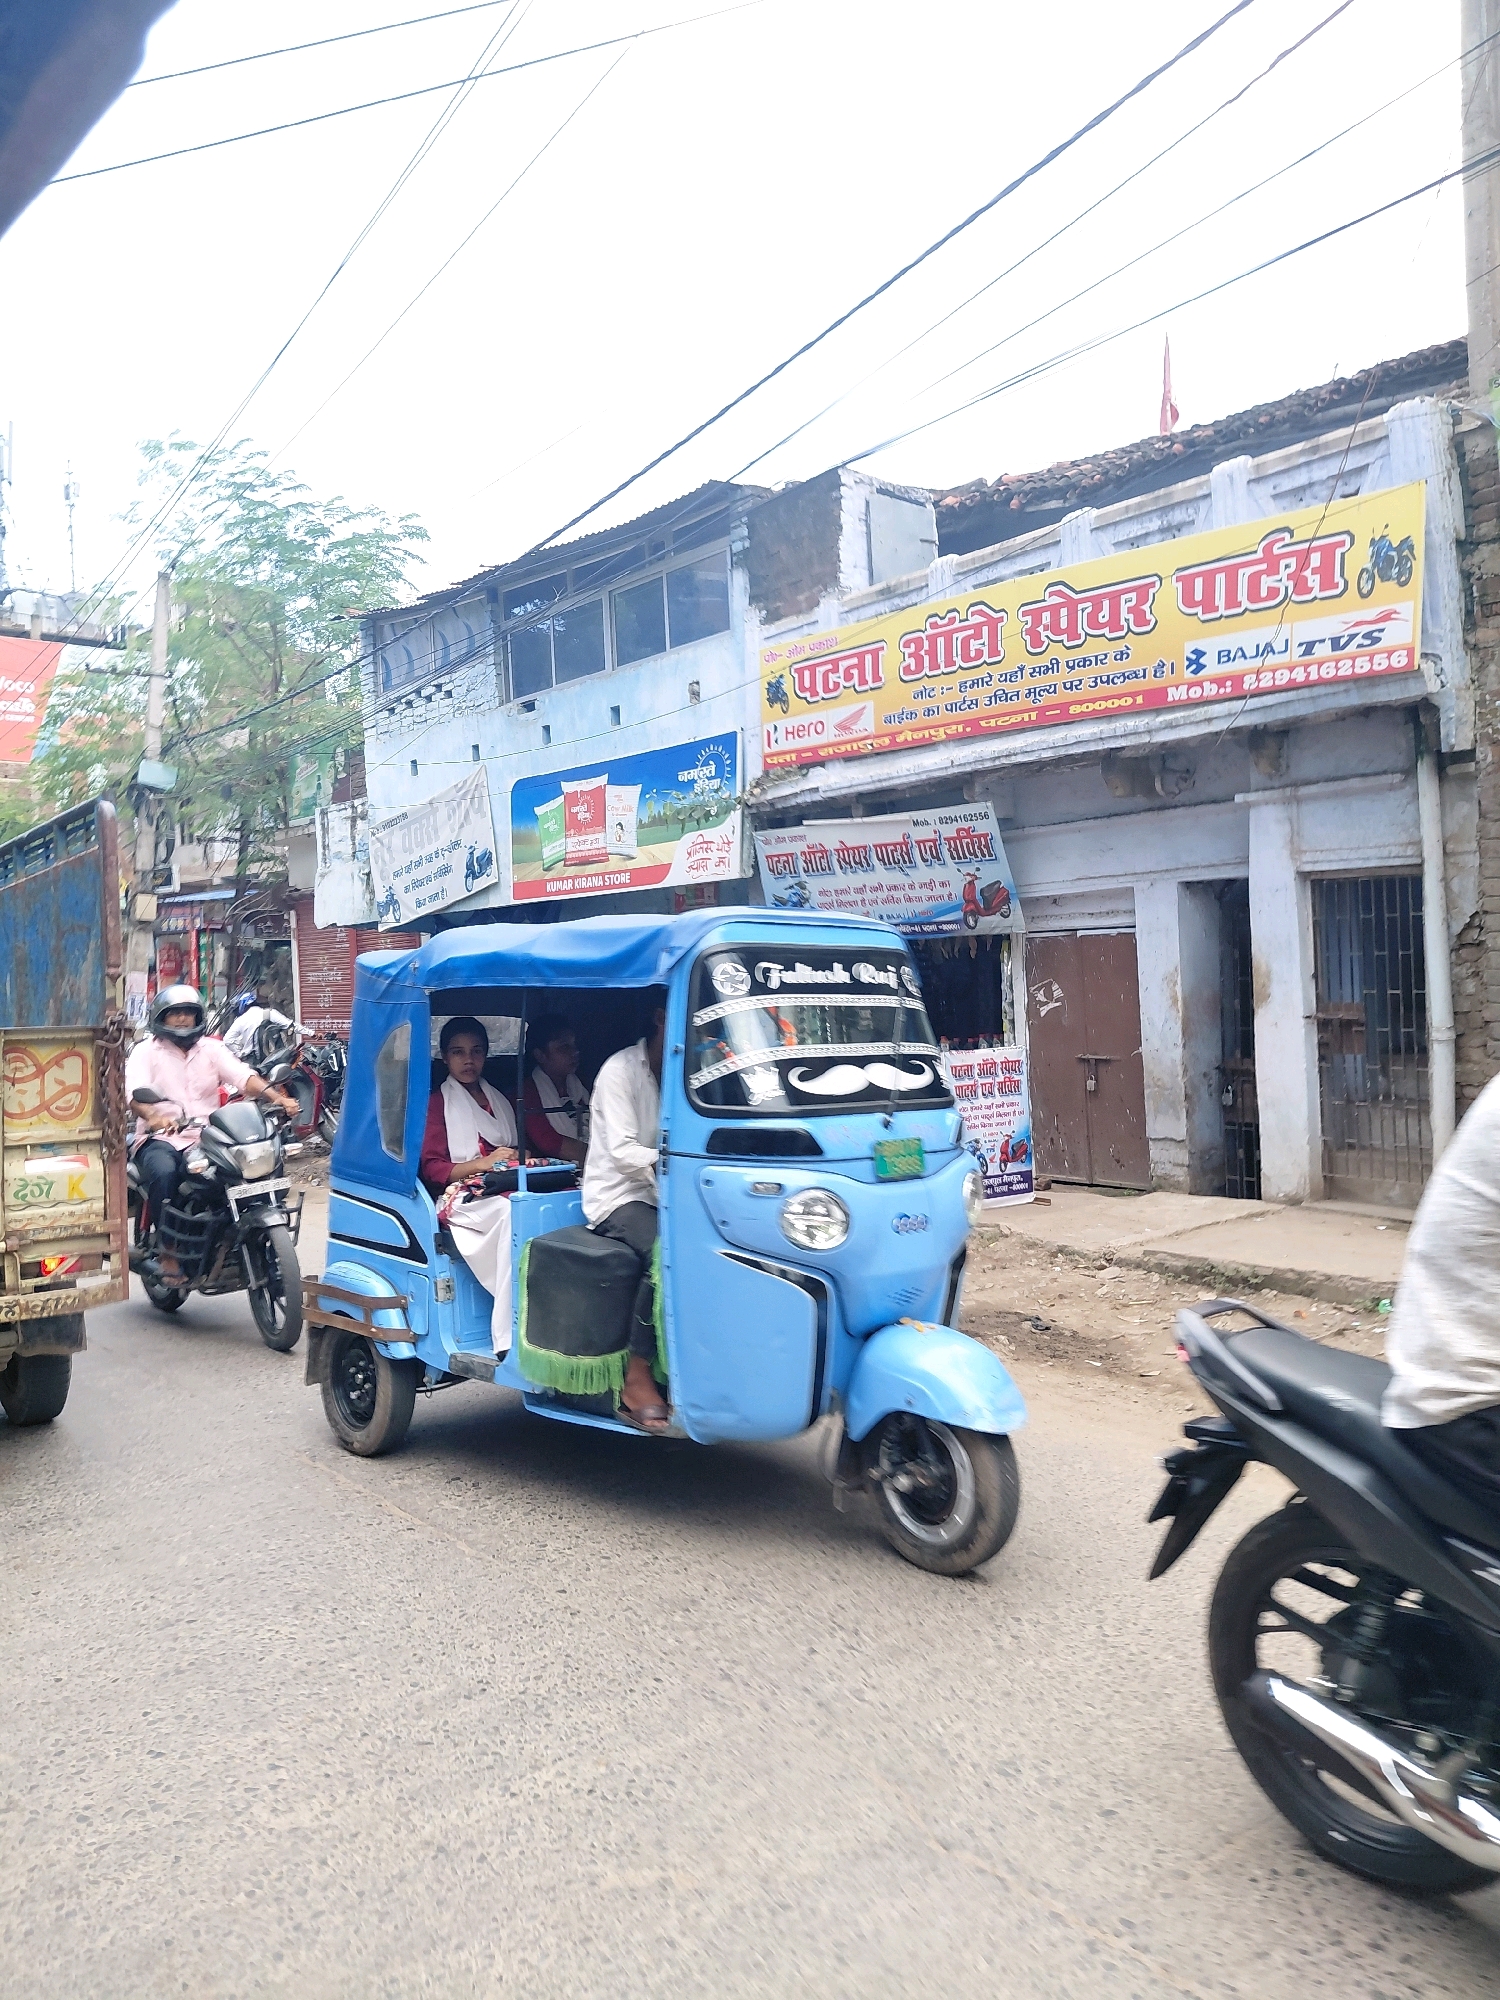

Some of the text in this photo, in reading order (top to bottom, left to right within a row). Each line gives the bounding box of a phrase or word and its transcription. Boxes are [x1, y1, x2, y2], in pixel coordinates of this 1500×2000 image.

[791, 529, 1353, 702] पटना ऑटो स्पेयर पार्टस
[1217, 638, 1290, 665] BAJAJ
[1297, 627, 1387, 658] TVS
[958, 671, 994, 692] हमारे
[997, 663, 1025, 685] यहाँ
[1028, 658, 1060, 679] सभी
[1065, 651, 1108, 675] प्रकार
[1113, 645, 1132, 662] के
[1242, 649, 1409, 691] 8294162556
[883, 706, 918, 725] बाईक
[922, 704, 940, 719] का
[983, 687, 1021, 707] उचित
[1025, 682, 1058, 705] मूल्य
[1062, 676, 1083, 692] पर
[1087, 667, 1147, 689] उपलब्ध
[764, 752, 798, 766] पता
[979, 711, 1039, 728] पटना
[1068, 694, 1144, 715] 800001
[784, 720, 825, 741] Hero
[677, 760, 718, 783] नमस्ते
[938, 811, 990, 825] 8294162556
[765, 852, 799, 877] पटना
[799, 842, 833, 876] ऑटो
[833, 840, 874, 871] स्पेयर
[914, 828, 943, 864] एवं
[943, 825, 995, 861] सर्विस
[546, 872, 631, 893] KUMAR KIRANA STORE
[950, 1055, 1022, 1079] पटना ऑटो स्पेयर
[980, 1077, 995, 1097] एवं
[67, 1173, 88, 1201] K
